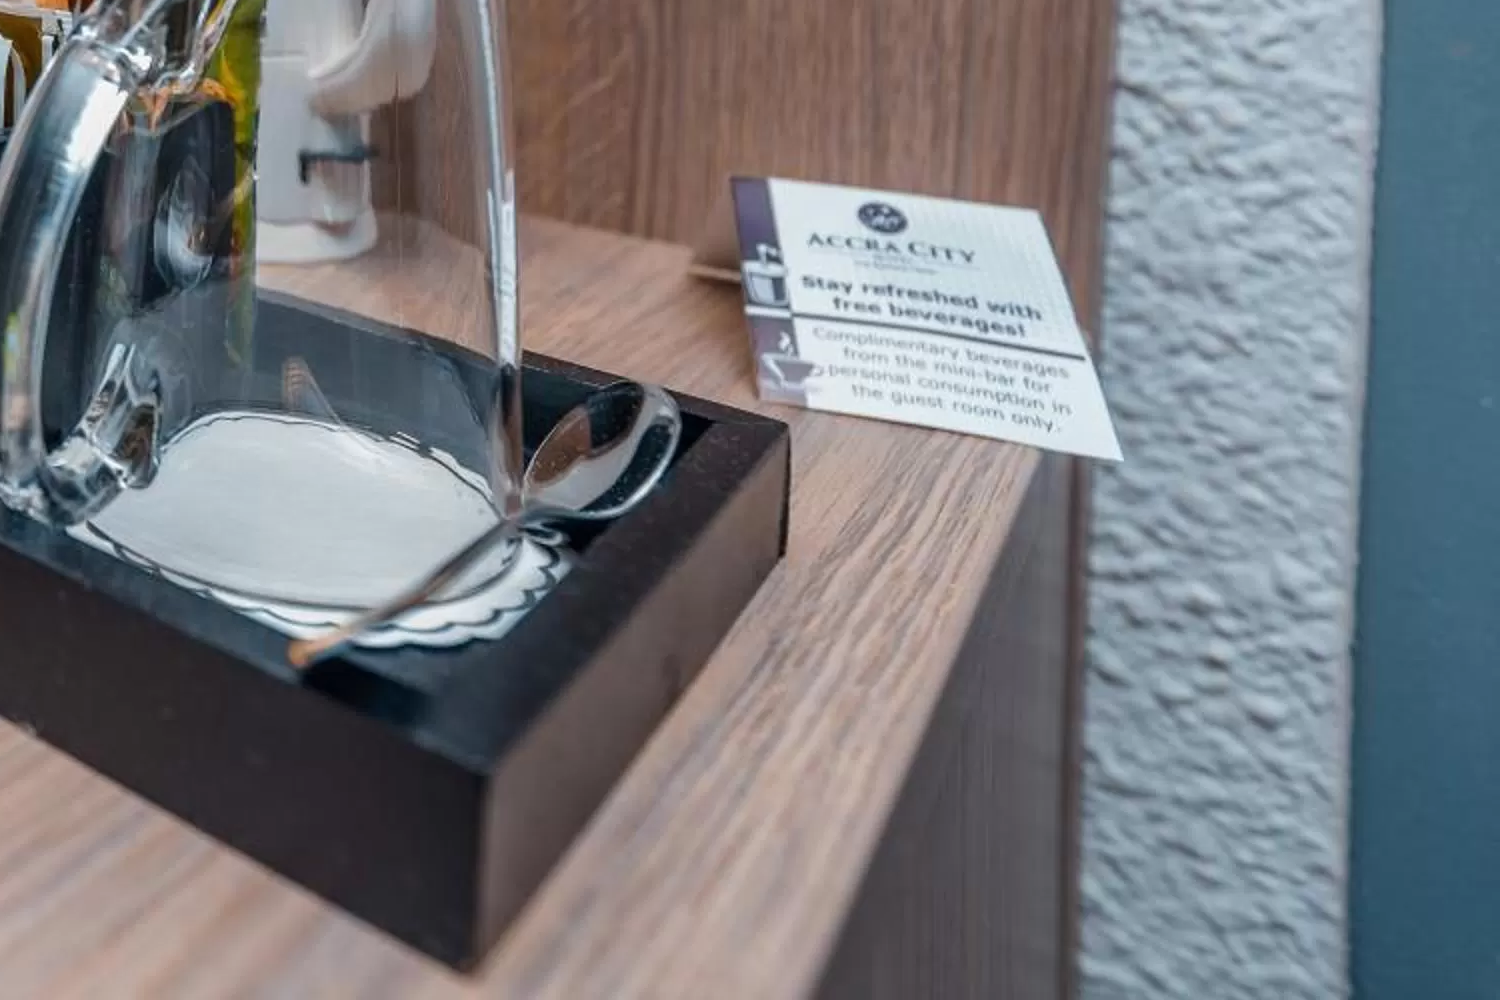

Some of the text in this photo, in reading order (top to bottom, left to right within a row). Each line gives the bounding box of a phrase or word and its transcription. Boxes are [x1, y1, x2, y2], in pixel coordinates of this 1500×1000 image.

[807, 231, 900, 253] ACCRA
[907, 241, 976, 264] CITY
[801, 275, 1042, 321] Stay refreshed with
[833, 297, 1026, 338] free beverages!
[812, 326, 1070, 379] Complimentary beverages
[843, 345, 1051, 393] from the mini-bar for
[828, 363, 1073, 416] personal consumption in
[851, 383, 883, 400] the
[891, 391, 943, 409] guest
[952, 401, 1005, 421] room
